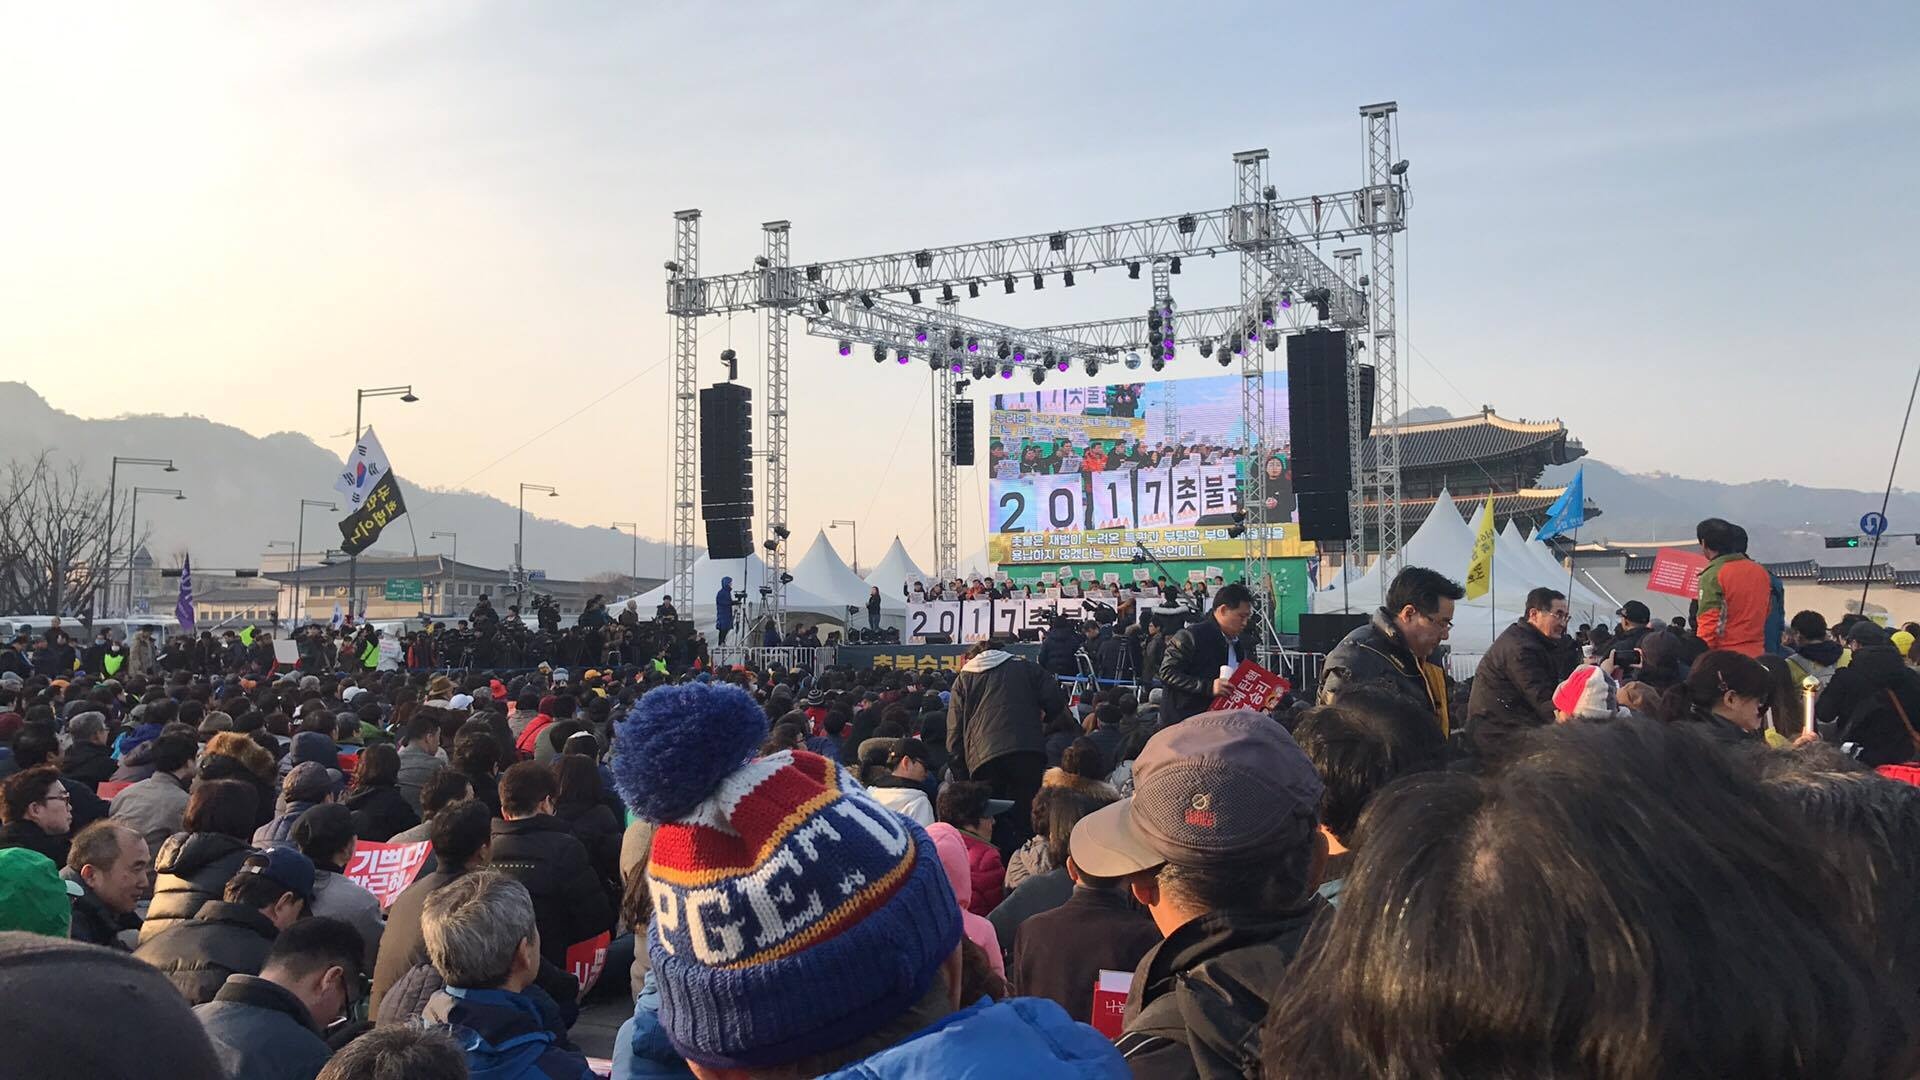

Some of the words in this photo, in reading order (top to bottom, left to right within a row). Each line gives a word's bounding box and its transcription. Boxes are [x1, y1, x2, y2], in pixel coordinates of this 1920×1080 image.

[1048, 533, 1082, 546] 재벌이
[1086, 531, 1120, 545] 누려온
[1164, 528, 1199, 542] 부당한
[1204, 528, 1229, 540] 부의
[1011, 548, 1055, 561] 용납하지
